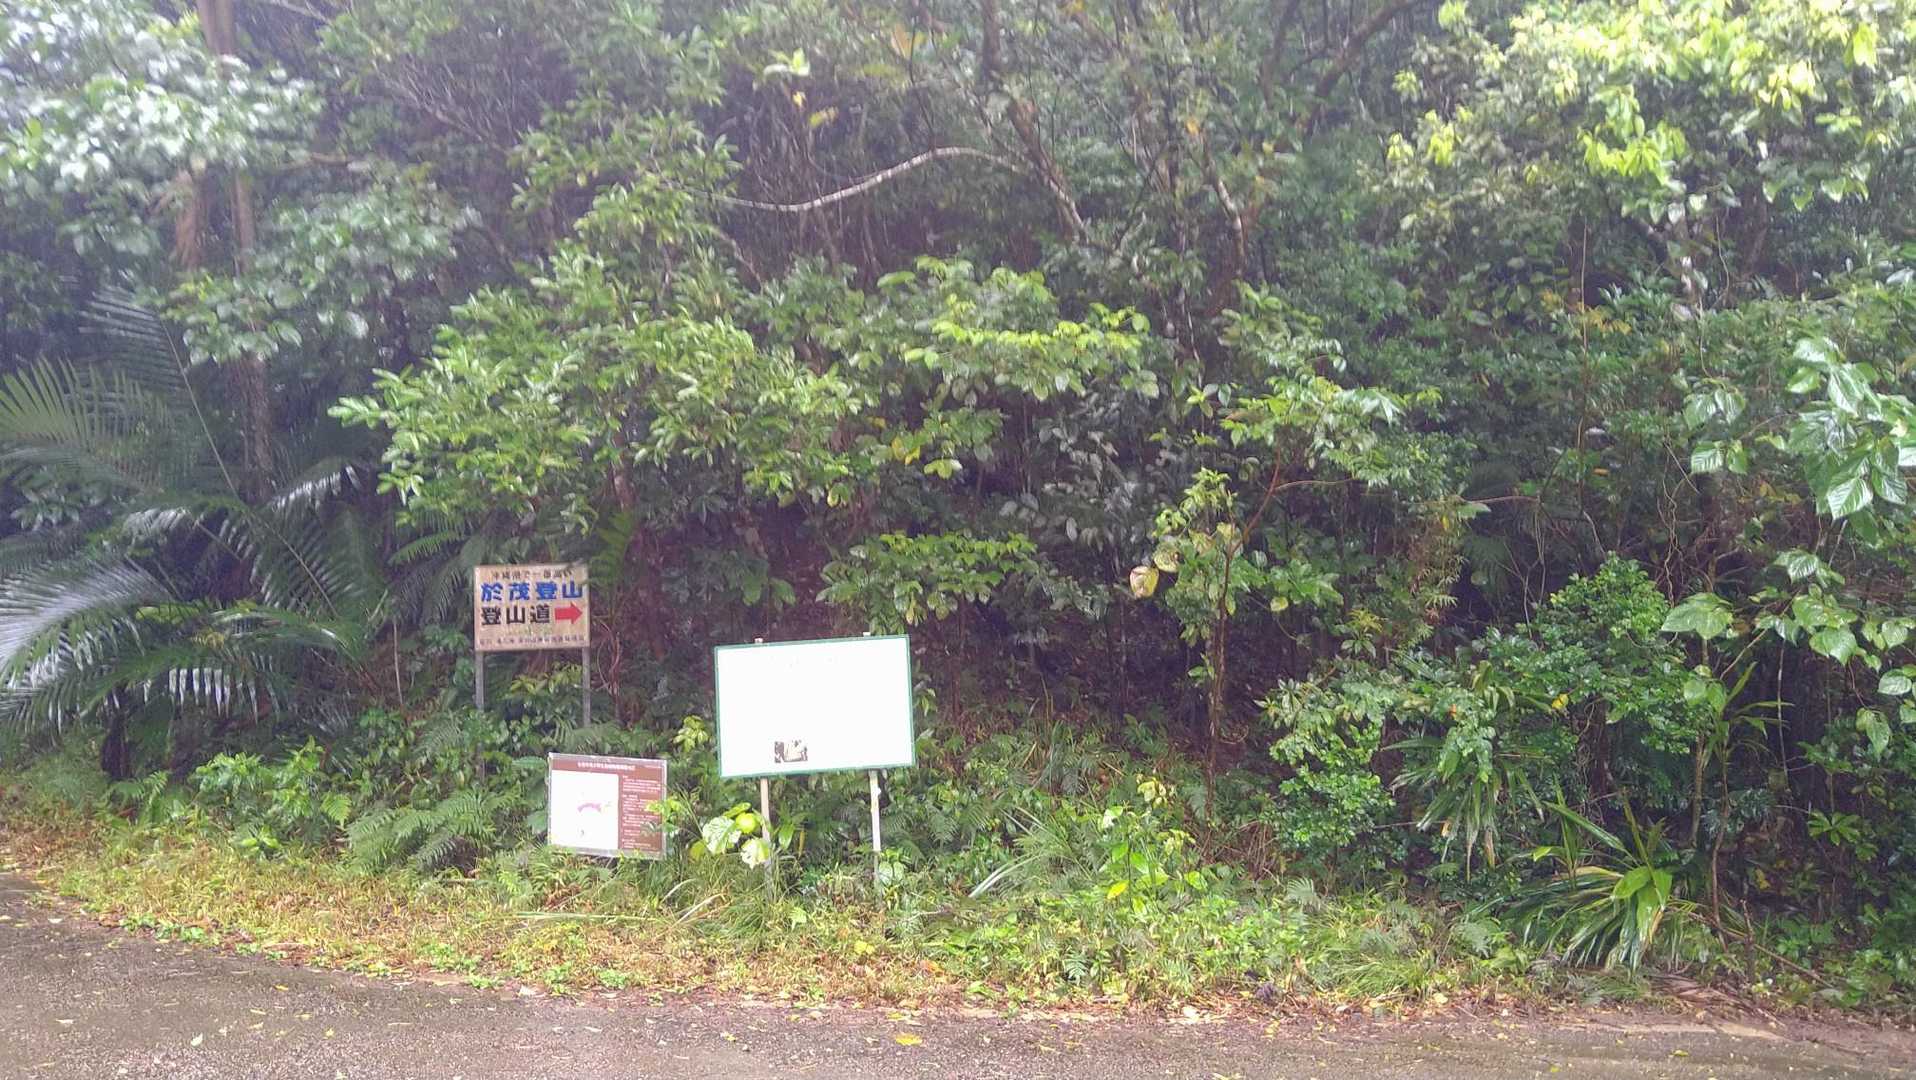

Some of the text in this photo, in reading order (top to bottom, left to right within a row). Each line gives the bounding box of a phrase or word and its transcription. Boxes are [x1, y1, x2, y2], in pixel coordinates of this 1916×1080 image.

[481, 579, 583, 602] 於茂登山
[481, 603, 550, 625] 登山道
